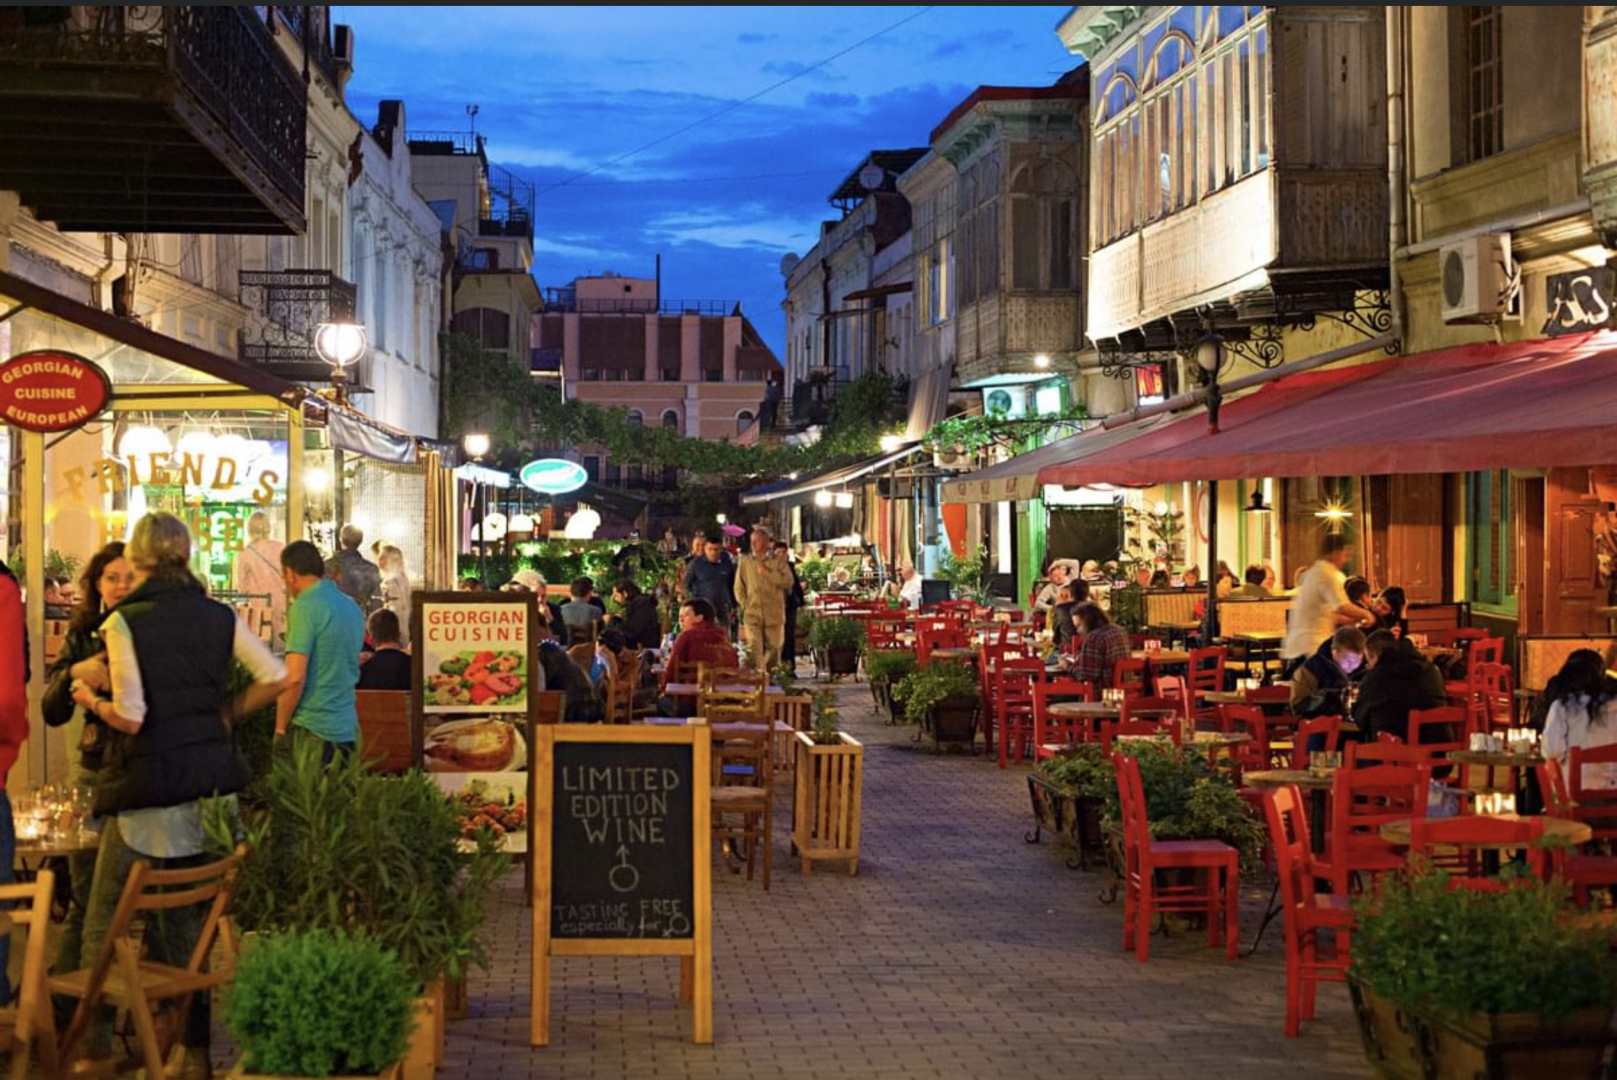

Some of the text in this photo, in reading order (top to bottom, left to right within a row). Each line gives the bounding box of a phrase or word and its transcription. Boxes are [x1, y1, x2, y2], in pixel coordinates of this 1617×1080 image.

[2, 361, 83, 384] GEORGIAN
[14, 388, 76, 399] CUISINE
[6, 405, 88, 424] EUROPEAN
[429, 610, 523, 624] GEORGIAN
[429, 627, 523, 641] CUISINE
[562, 765, 680, 792] LIMITED
[571, 793, 667, 818] EDITION
[582, 817, 665, 844] WINE
[640, 899, 681, 917] FREE
